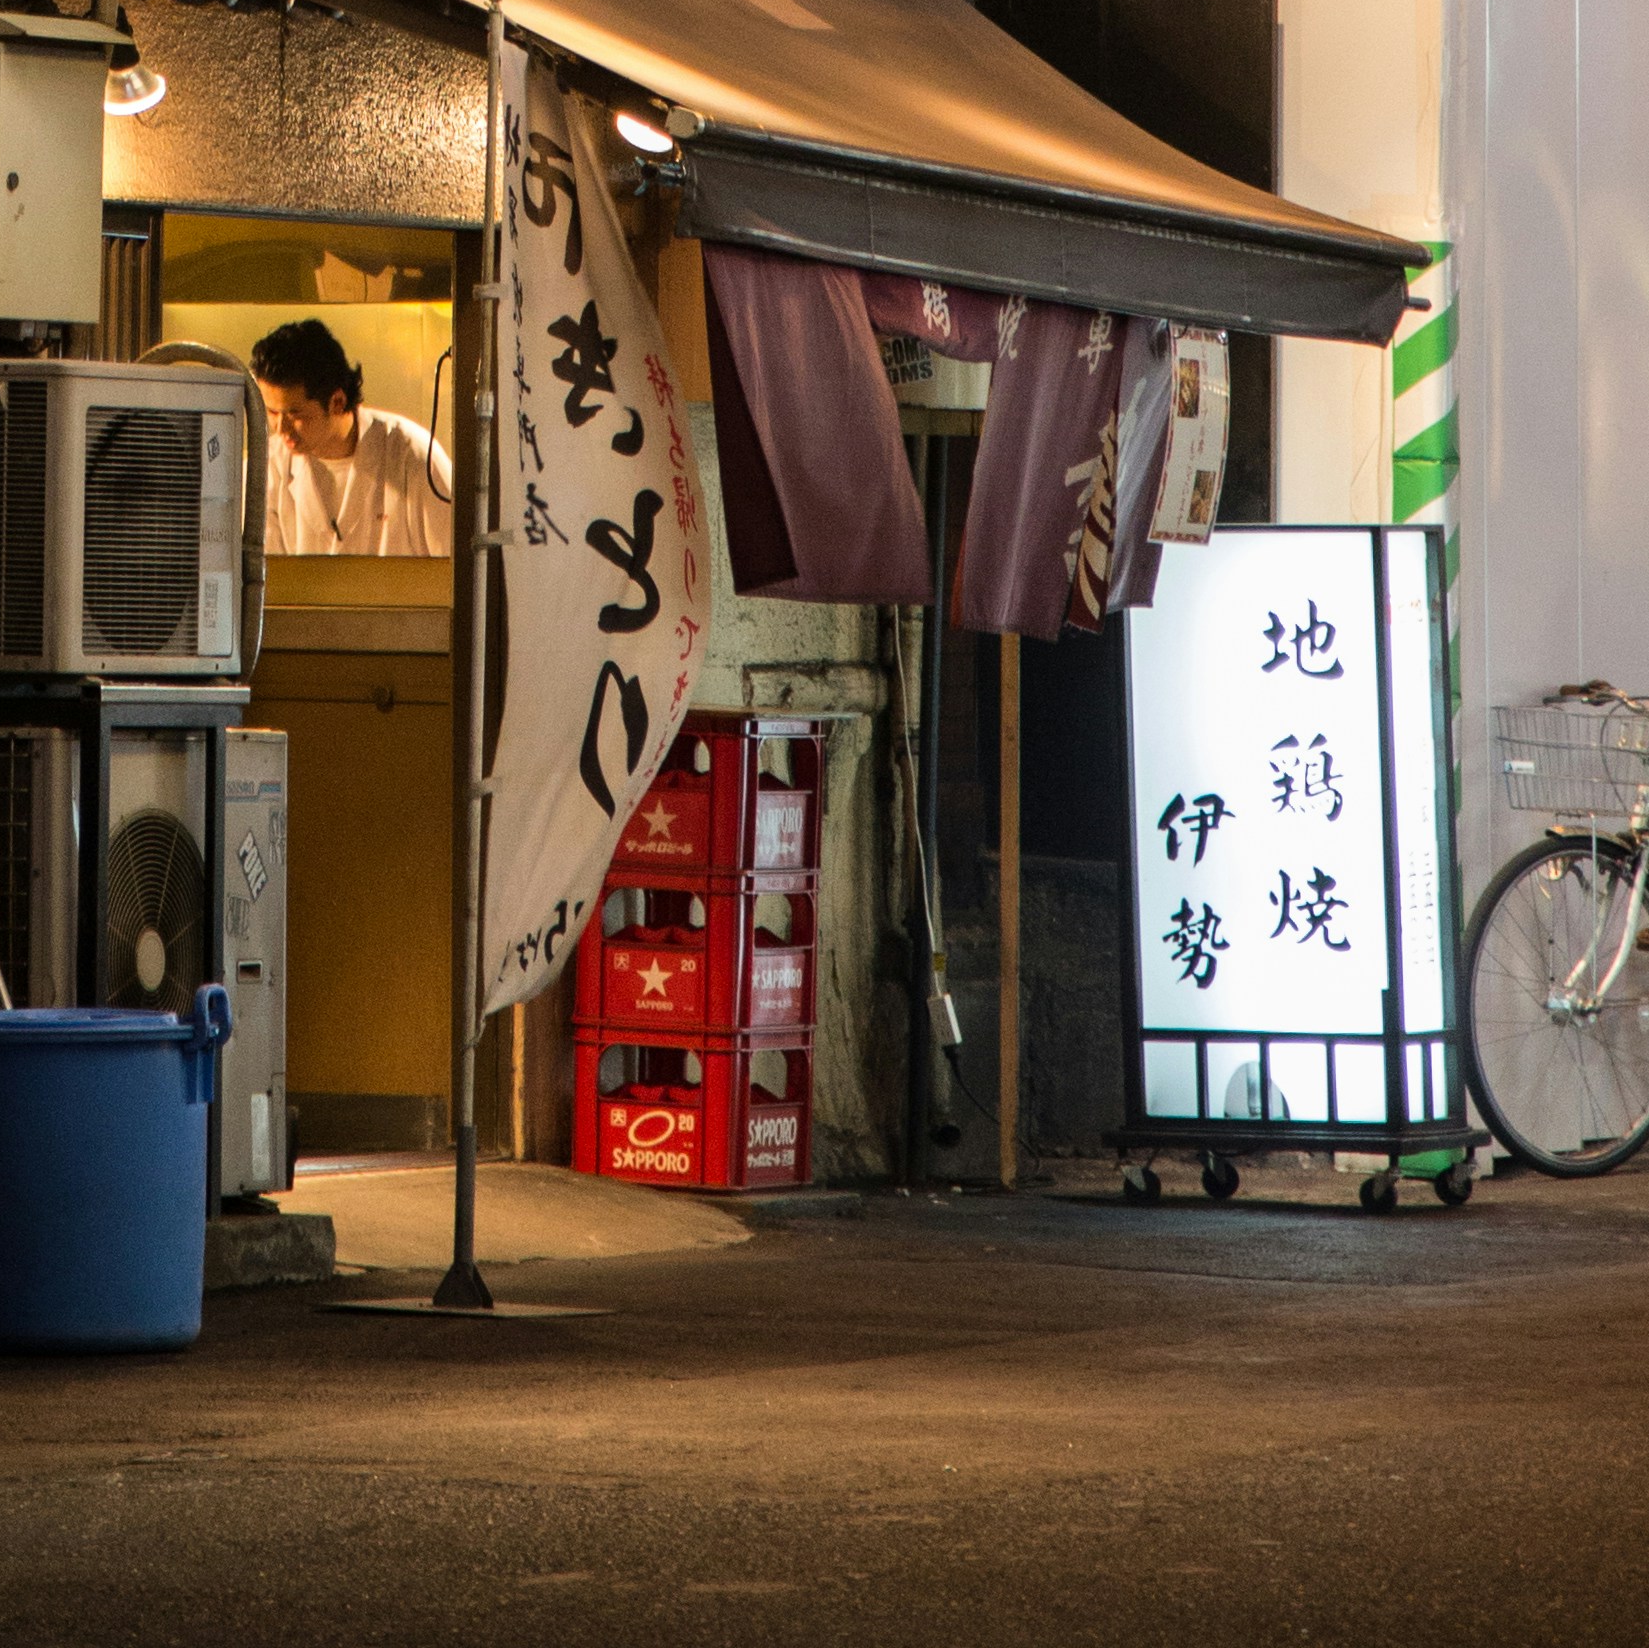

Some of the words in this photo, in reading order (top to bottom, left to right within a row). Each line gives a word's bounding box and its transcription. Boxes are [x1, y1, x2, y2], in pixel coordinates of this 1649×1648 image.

[1260, 598, 1352, 954] 地鶏焼
[1156, 790, 1236, 991] 伊勢
[680, 959, 697, 973] 20
[761, 967, 803, 990] SAPPORO
[678, 1113, 695, 1132] 20
